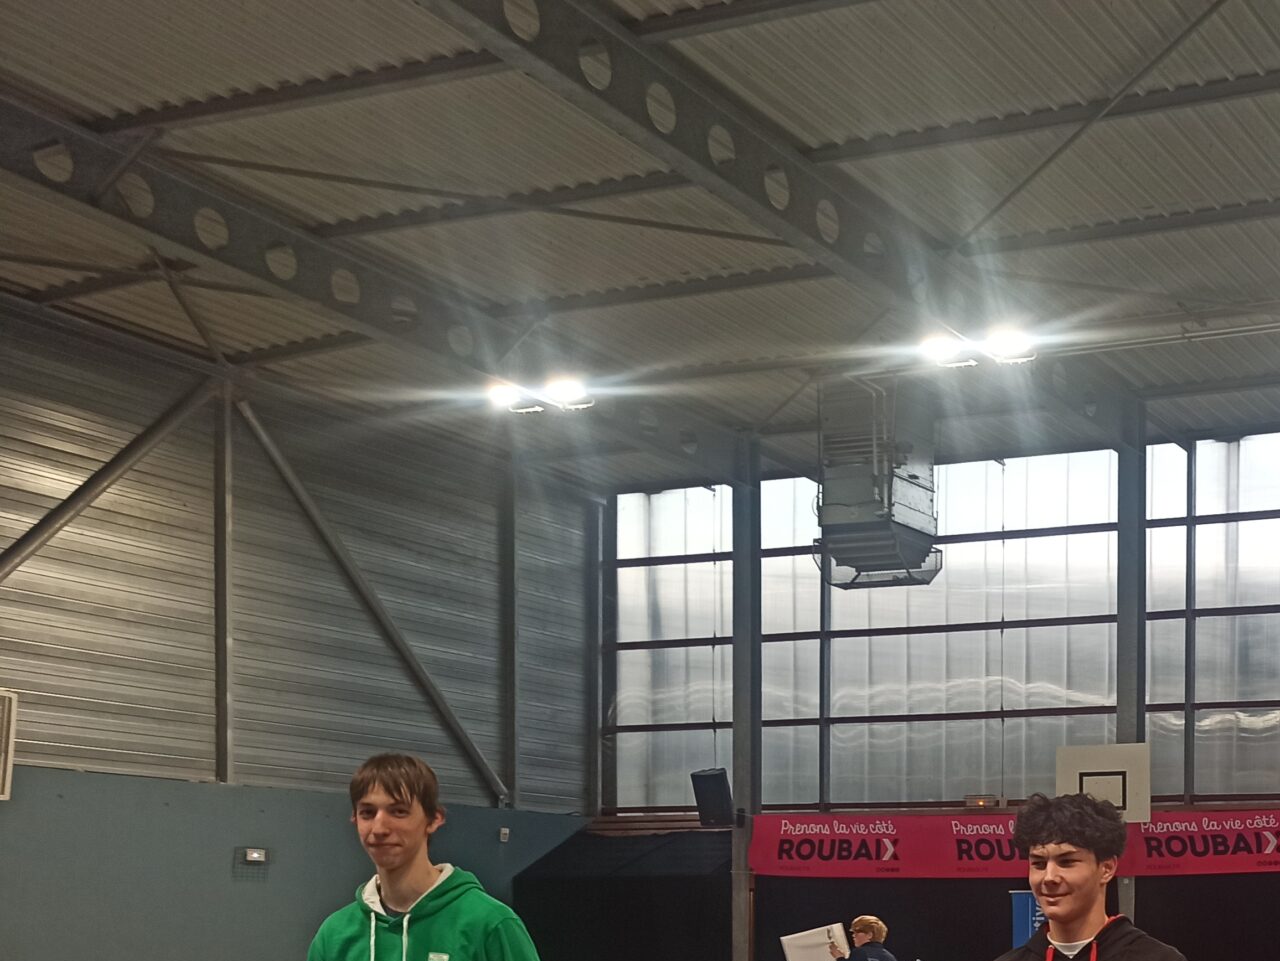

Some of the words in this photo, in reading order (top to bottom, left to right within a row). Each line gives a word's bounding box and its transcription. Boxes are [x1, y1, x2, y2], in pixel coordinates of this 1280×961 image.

[780, 820, 830, 835] Prenons
[833, 820, 850, 835] la
[850, 820, 868, 835] vie
[868, 819, 897, 835] côté
[951, 820, 1005, 836] Prenons
[1140, 821, 1199, 833] Prenons
[1202, 817, 1222, 832] la
[1222, 817, 1244, 830] vie
[1246, 814, 1280, 829] côté
[777, 838, 900, 861] ROUBAIX
